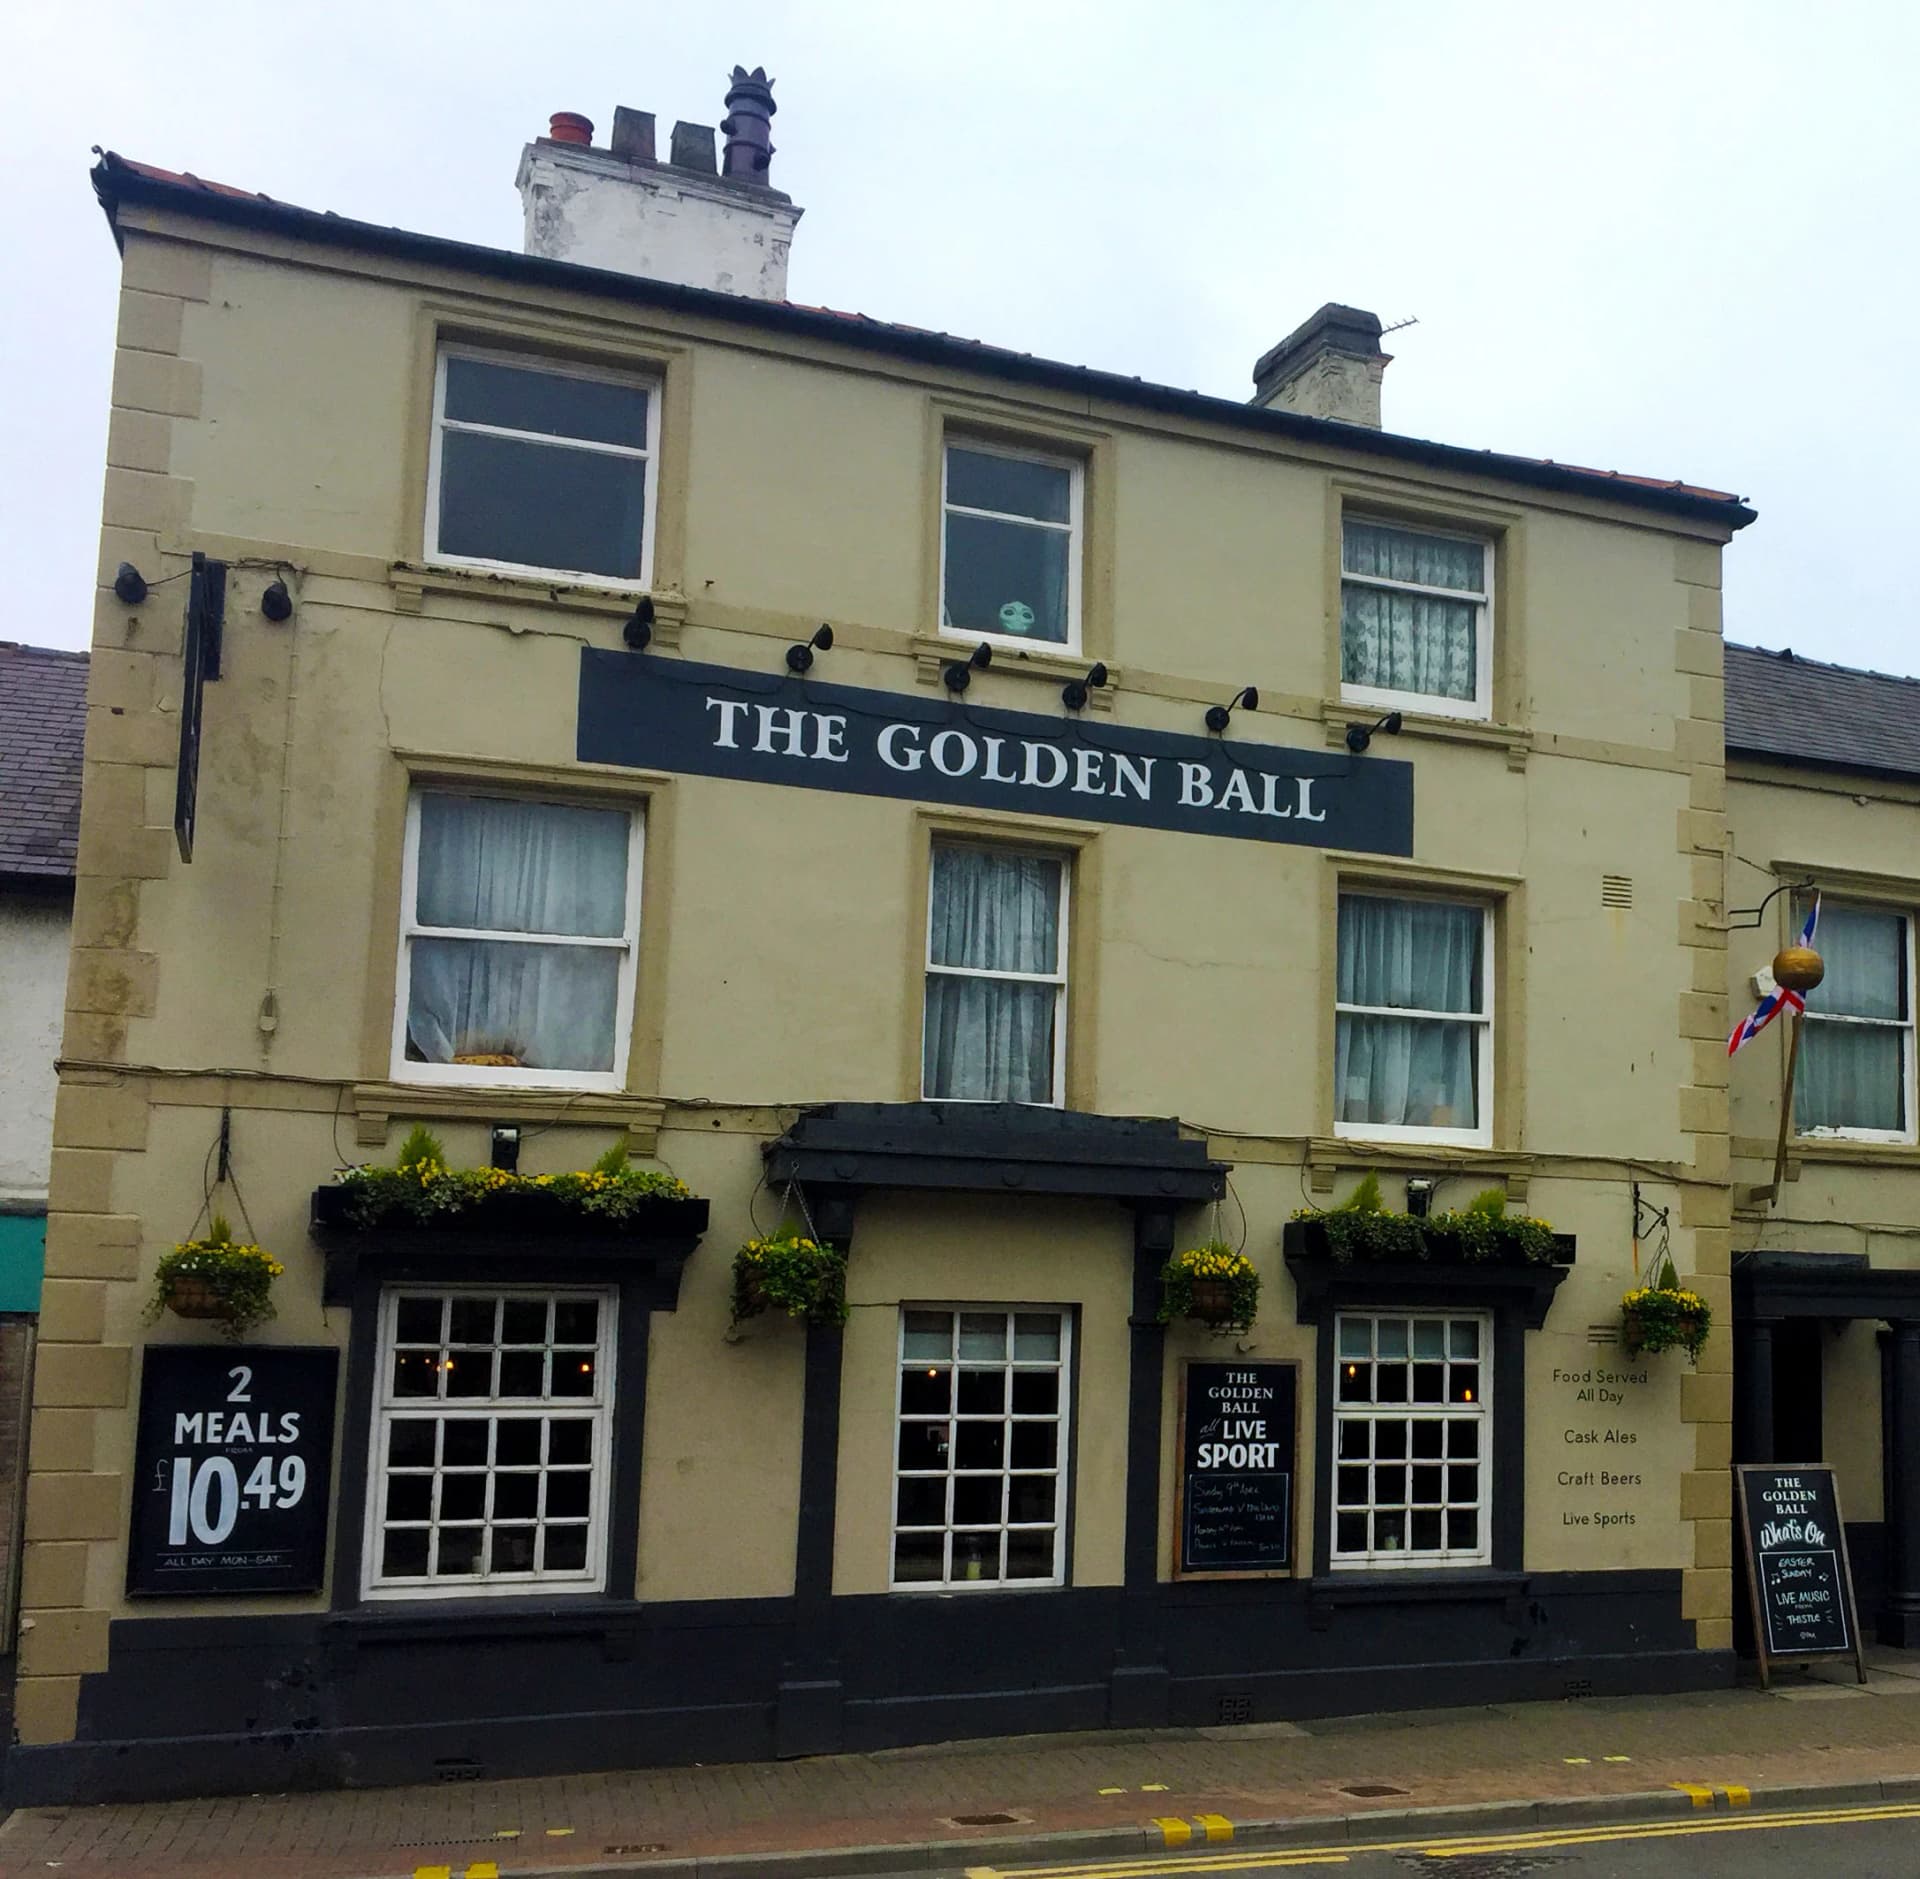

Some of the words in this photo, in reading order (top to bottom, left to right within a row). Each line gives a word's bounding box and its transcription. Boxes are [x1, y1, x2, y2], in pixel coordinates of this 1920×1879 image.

[705, 697, 848, 762] THE
[878, 724, 1155, 800] GOLDEN
[1177, 762, 1326, 823] BALL
[1226, 1373, 1257, 1384] THE
[1553, 1369, 1591, 1383] Food
[1596, 1370, 1647, 1384] Served
[227, 1366, 252, 1402] 2
[1208, 1387, 1273, 1399] GOLDEN
[1577, 1389, 1593, 1402] All
[1599, 1389, 1624, 1405] Day
[1222, 1402, 1260, 1413] BALL
[175, 1412, 300, 1444] MEALS
[1200, 1418, 1221, 1434] all
[1223, 1420, 1266, 1439] LIVE
[1564, 1430, 1598, 1444] Cask
[1604, 1430, 1637, 1444] Ales
[1197, 1443, 1279, 1468] SPORT
[1558, 1472, 1594, 1486] Craft
[1601, 1472, 1642, 1485] Beers
[1775, 1478, 1801, 1488] THE
[1763, 1490, 1816, 1501] GOLDEN
[1776, 1504, 1808, 1514] BALL
[1563, 1512, 1589, 1525] Live
[1594, 1512, 1635, 1528] Sports
[1761, 1519, 1802, 1549] What's
[1805, 1521, 1826, 1546] On
[164, 1557, 185, 1566] ALL
[192, 1557, 215, 1565] DAY
[1778, 1557, 1815, 1567] EASTER
[1781, 1569, 1812, 1579] SUNDAY
[1776, 1592, 1796, 1605] LIVE
[1799, 1590, 1830, 1602] MUSIC
[1787, 1614, 1821, 1625] THISTLE
